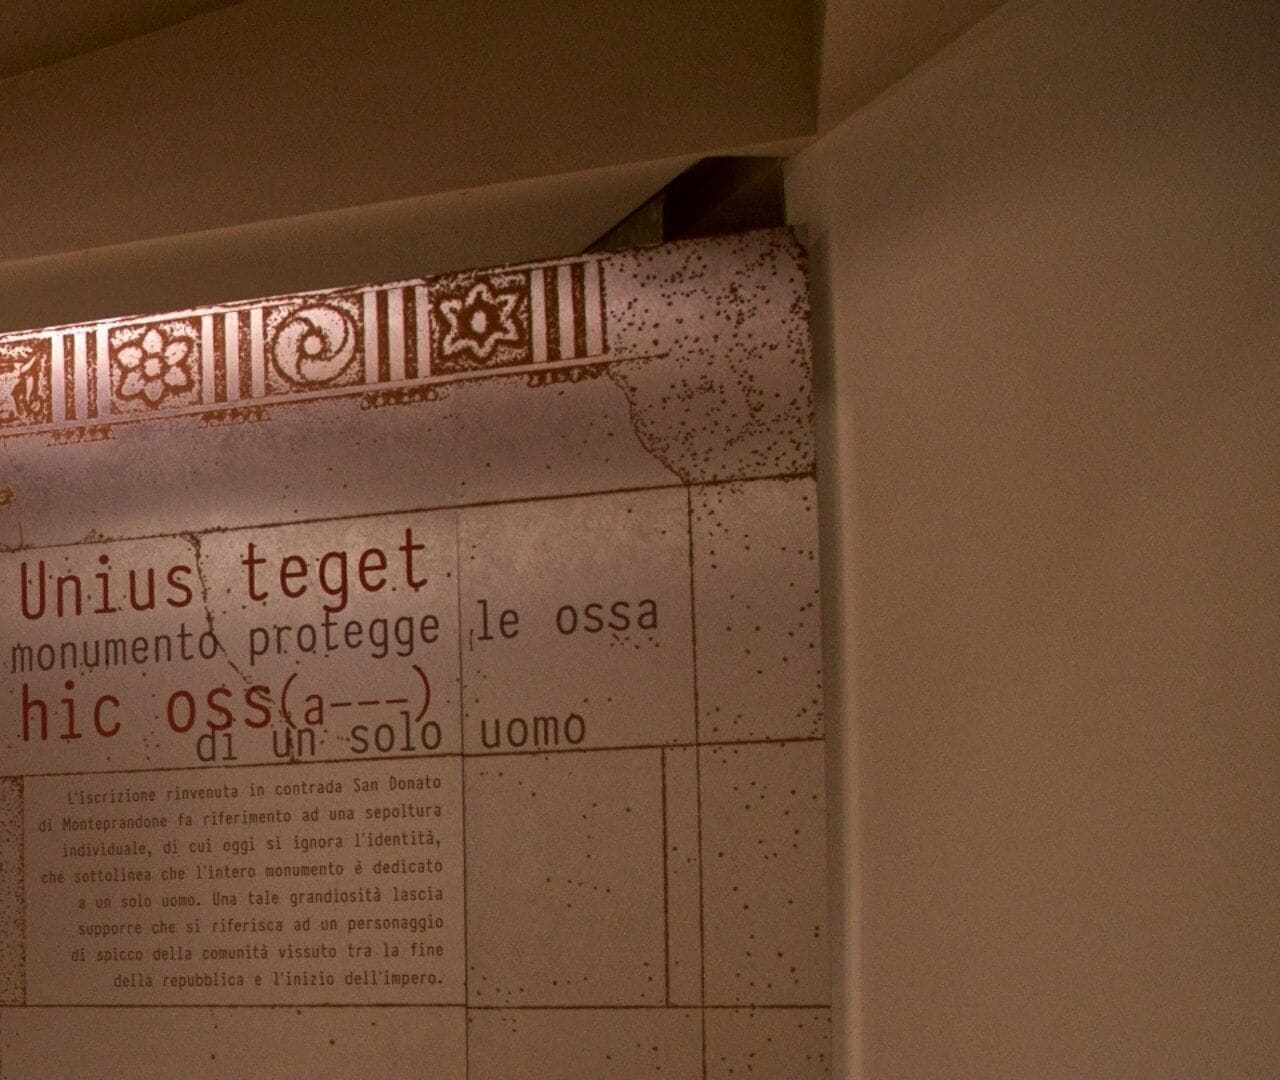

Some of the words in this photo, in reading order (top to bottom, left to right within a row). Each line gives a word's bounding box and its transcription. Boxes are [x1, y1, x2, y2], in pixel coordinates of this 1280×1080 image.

[20, 554, 193, 620] Unius
[242, 528, 427, 613] teget
[10, 623, 218, 674] monumento
[250, 612, 439, 667] protegge
[477, 599, 520, 641] le
[557, 598, 658, 635] ossa
[22, 680, 121, 742] hic
[197, 723, 237, 762] di
[272, 727, 316, 758] un
[351, 711, 442, 754] solo
[481, 714, 586, 749] uomo
[67, 788, 156, 805] L'iscrizione
[166, 784, 239, 801] rinvenuta
[249, 783, 265, 797] in
[275, 779, 343, 796] contrada
[353, 777, 379, 793] San
[389, 775, 441, 791] Donato
[38, 818, 53, 833] di
[62, 814, 168, 833] Monteprandone
[178, 812, 193, 827] fa
[203, 808, 292, 826] riferimento
[302, 807, 319, 822] ad
[329, 808, 355, 821] una
[366, 803, 441, 822] sepoltura
[62, 841, 153, 858] individuale,
[163, 840, 178, 855] di
[189, 838, 213, 853] cui
[223, 837, 256, 855] oggi
[267, 835, 282, 850] si
[293, 834, 344, 853] ignora
[354, 830, 441, 848] l'identità,
[41, 870, 64, 884] che
[74, 867, 152, 884] sottolinea
[161, 866, 186, 881] che
[196, 864, 256, 880] l'intero
[265, 861, 344, 878] monumento
[354, 860, 363, 875] è
[373, 857, 443, 875] dedicato
[78, 899, 86, 909] a
[95, 898, 112, 909] un
[121, 893, 152, 908] solo
[161, 895, 201, 907] uomo.
[212, 891, 238, 906] Una
[248, 890, 280, 905] tale
[290, 887, 381, 907] grandiosità
[393, 886, 444, 902] lascia
[78, 922, 142, 937] supporre
[151, 920, 176, 934] che
[186, 919, 201, 933] si
[212, 918, 283, 933] riferisca
[294, 918, 310, 931] ad
[321, 919, 338, 930] un
[348, 914, 444, 933] personaggio
[71, 947, 86, 961] di
[96, 947, 143, 963] spicco
[153, 946, 192, 961] della
[202, 944, 268, 961] comunità
[279, 943, 337, 959] vissuto
[348, 943, 372, 958] tra
[383, 942, 399, 957] la
[411, 942, 444, 957] fine
[113, 973, 153, 988] della
[162, 972, 244, 990] repubblica
[254, 974, 262, 986] e
[273, 971, 335, 986] l'inizio
[344, 970, 443, 988] dell'impero.
